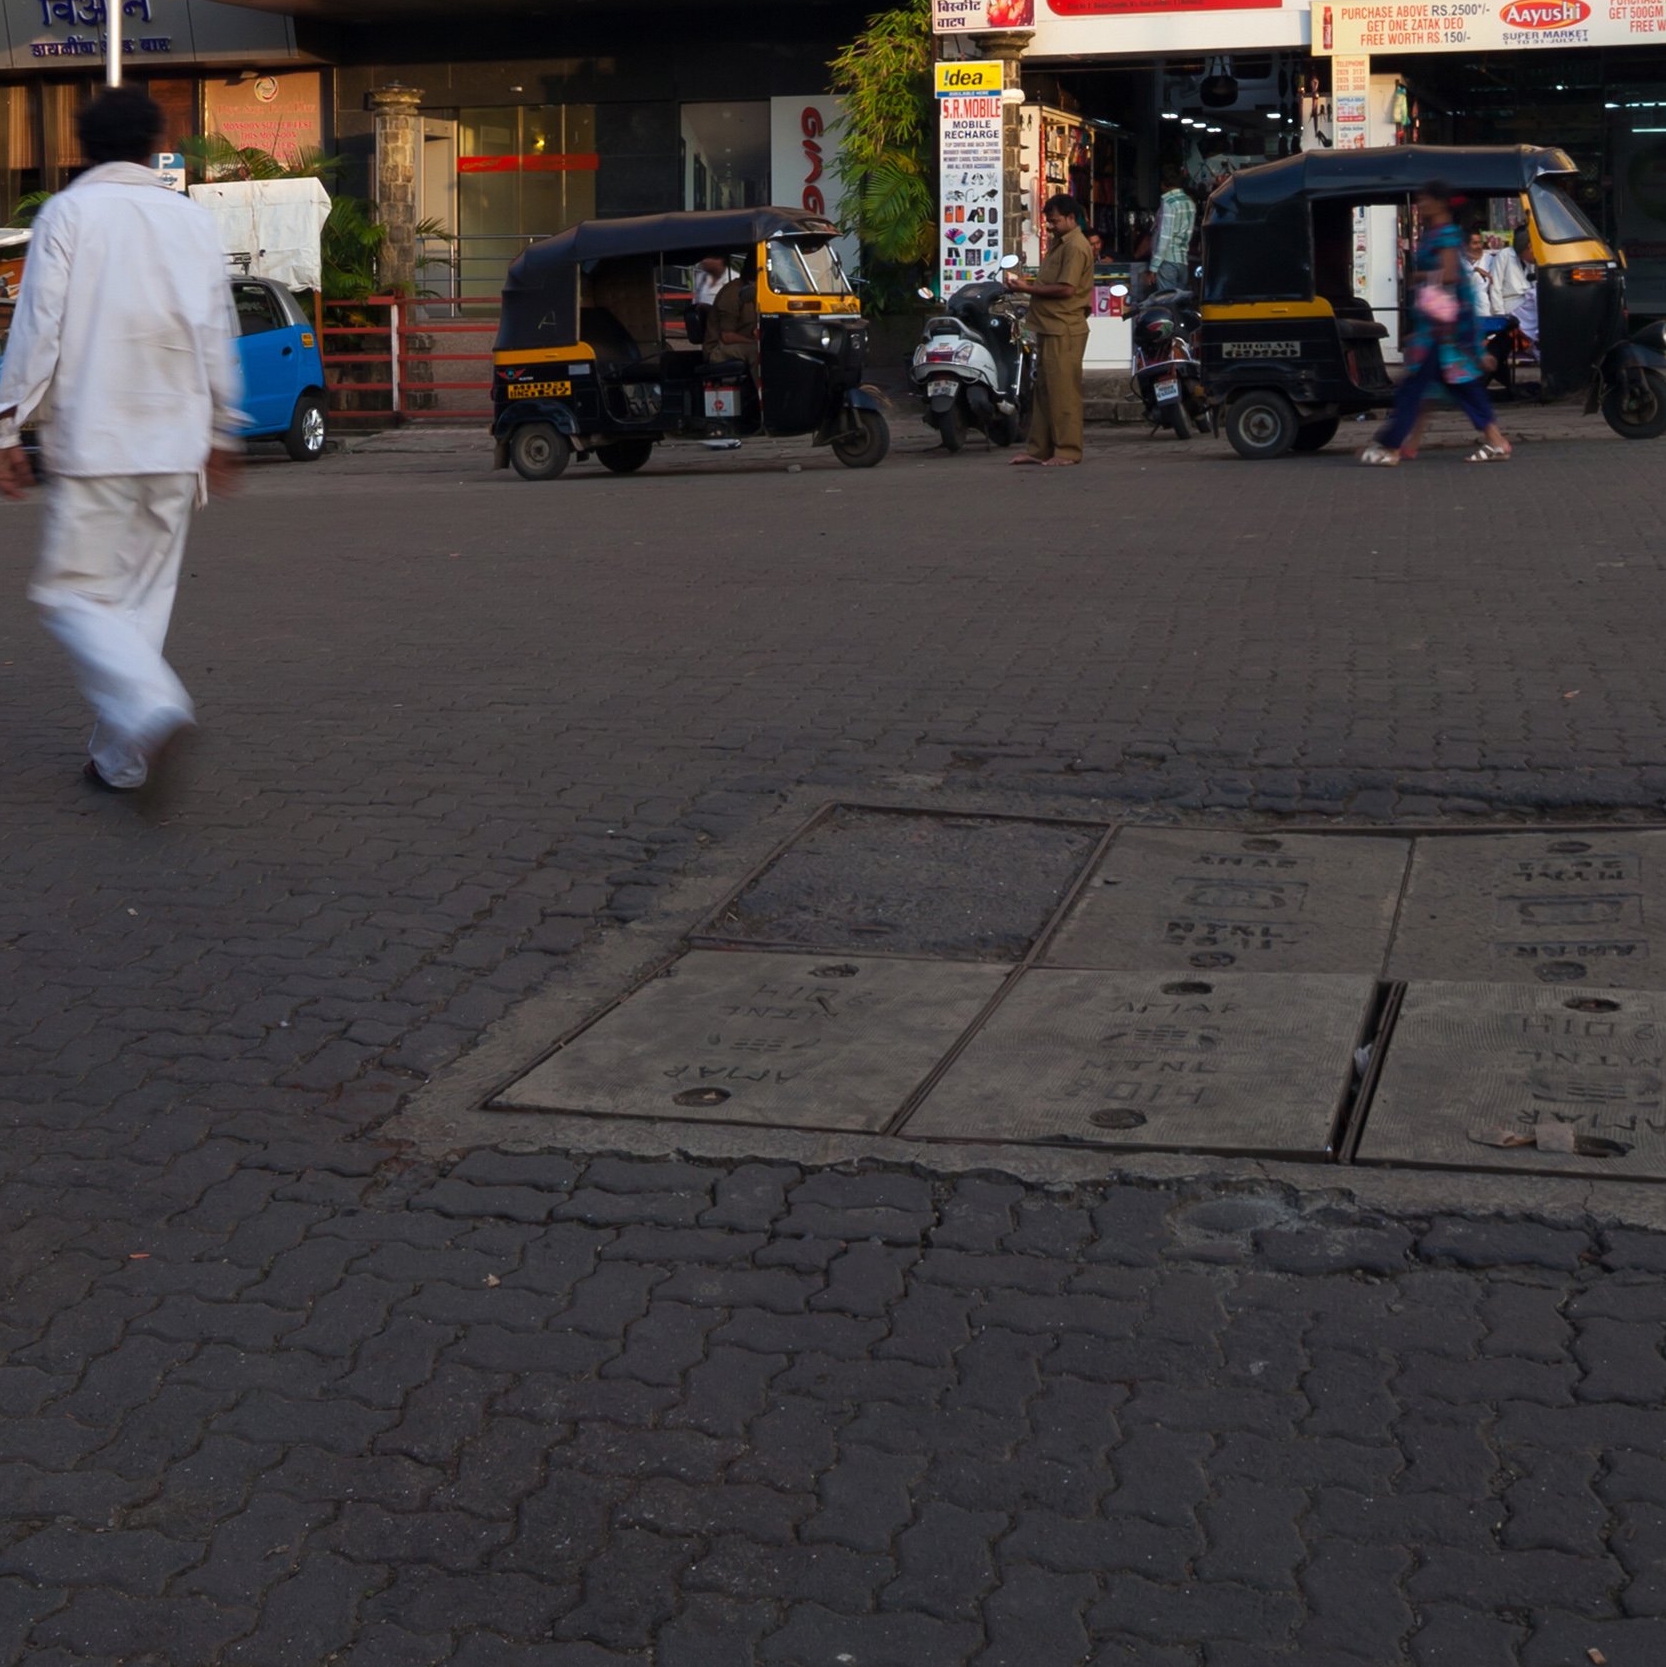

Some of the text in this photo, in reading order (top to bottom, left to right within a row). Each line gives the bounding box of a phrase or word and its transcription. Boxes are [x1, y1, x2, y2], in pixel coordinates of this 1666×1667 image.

[1609, 7, 1627, 20] GET
[1630, 5, 1663, 19] 500GM
[943, 98, 1001, 119] S.R.MOBILE
[953, 120, 991, 129] MOBILE
[945, 130, 999, 139] RECHARGE
[159, 153, 175, 170] P
